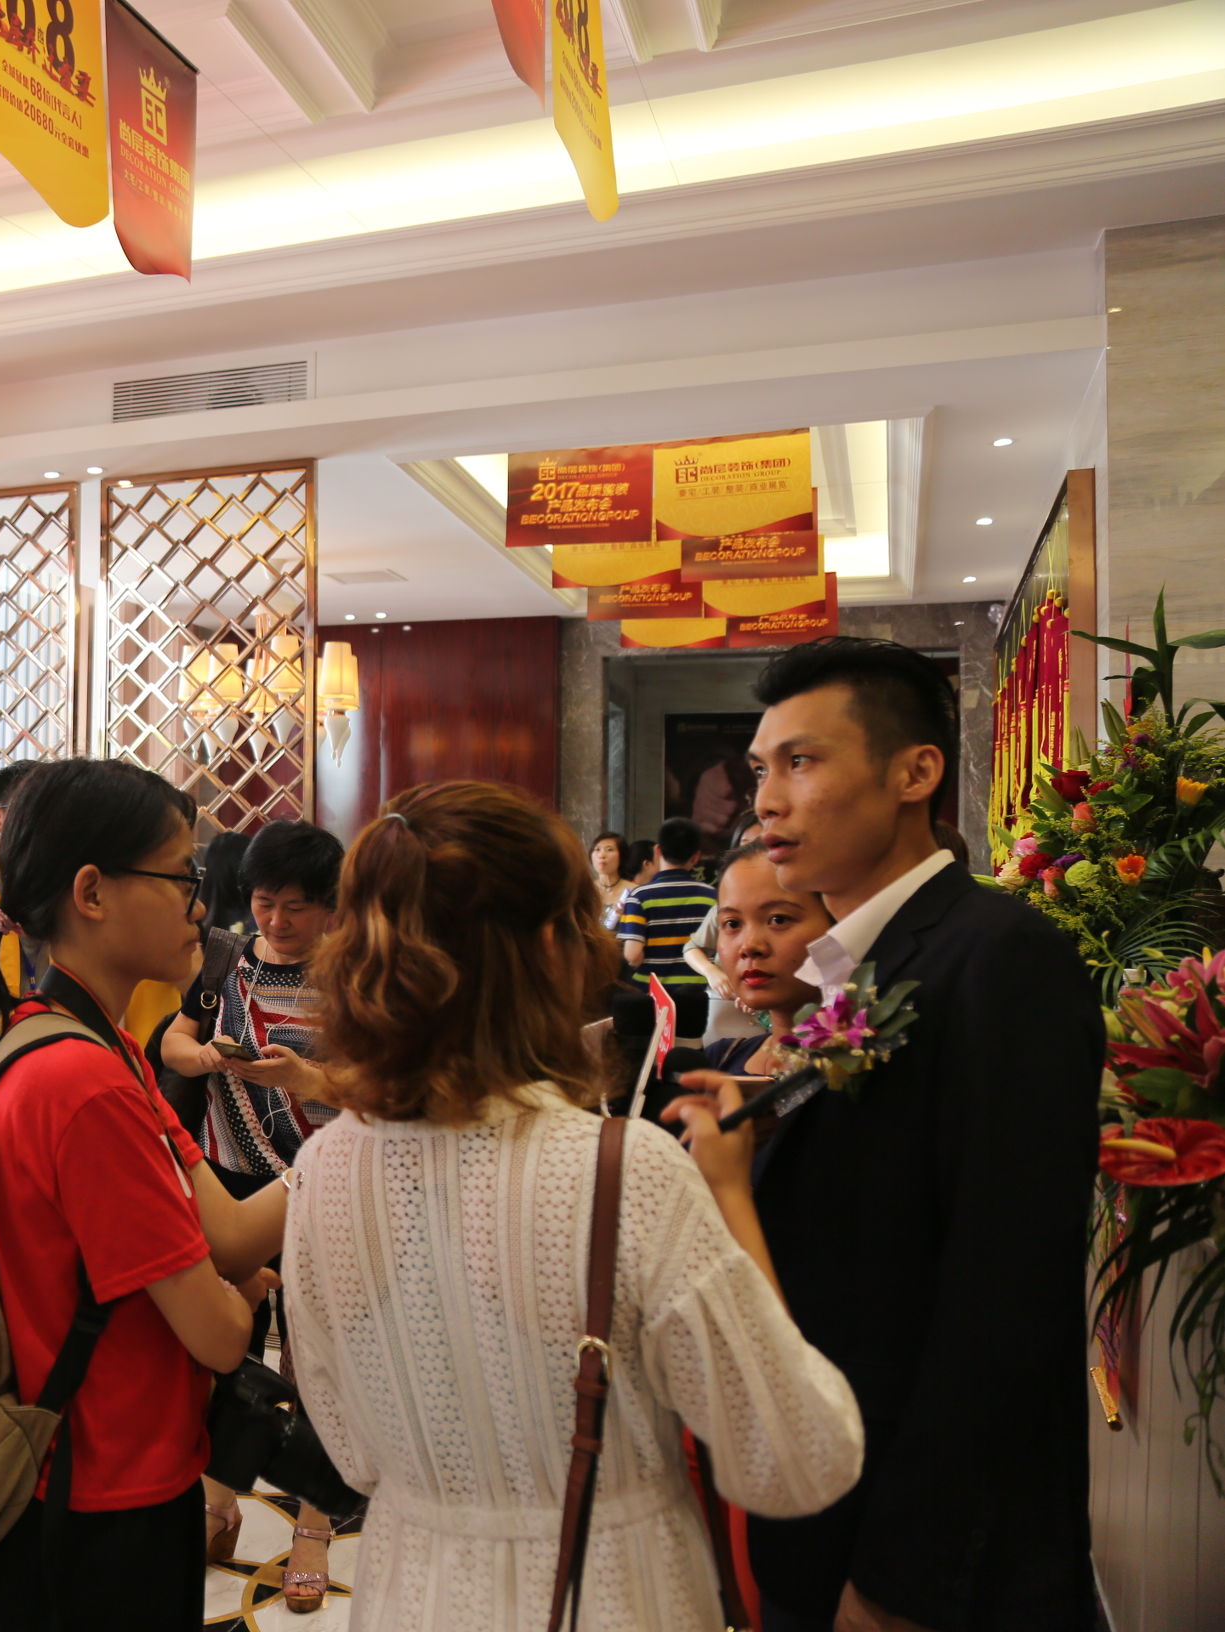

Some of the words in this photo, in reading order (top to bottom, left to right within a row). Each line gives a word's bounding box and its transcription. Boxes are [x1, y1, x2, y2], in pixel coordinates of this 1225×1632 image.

[119, 118, 190, 192] 尚层装饰集团
[120, 144, 166, 188] DECORATION
